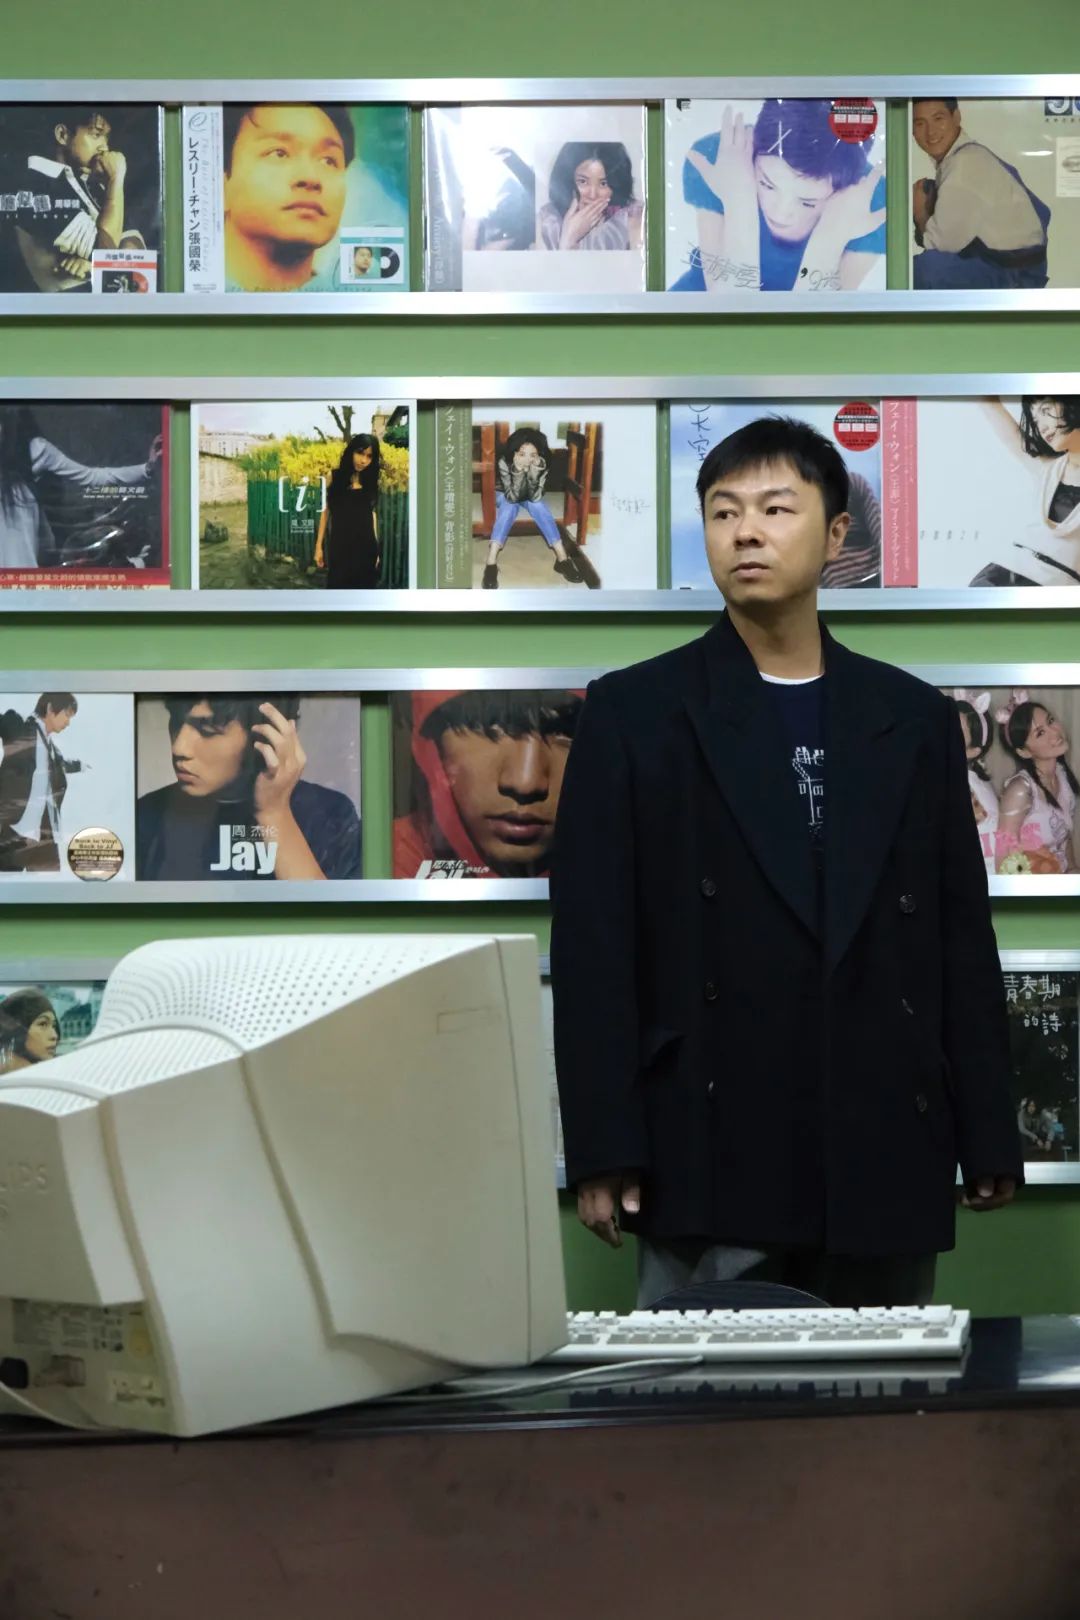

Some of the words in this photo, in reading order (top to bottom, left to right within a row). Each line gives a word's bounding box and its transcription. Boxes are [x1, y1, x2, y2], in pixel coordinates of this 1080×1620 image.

[210, 824, 278, 875] Jay
[1003, 974, 1061, 1004] 青春期
[1023, 1012, 1062, 1036] 的詩
